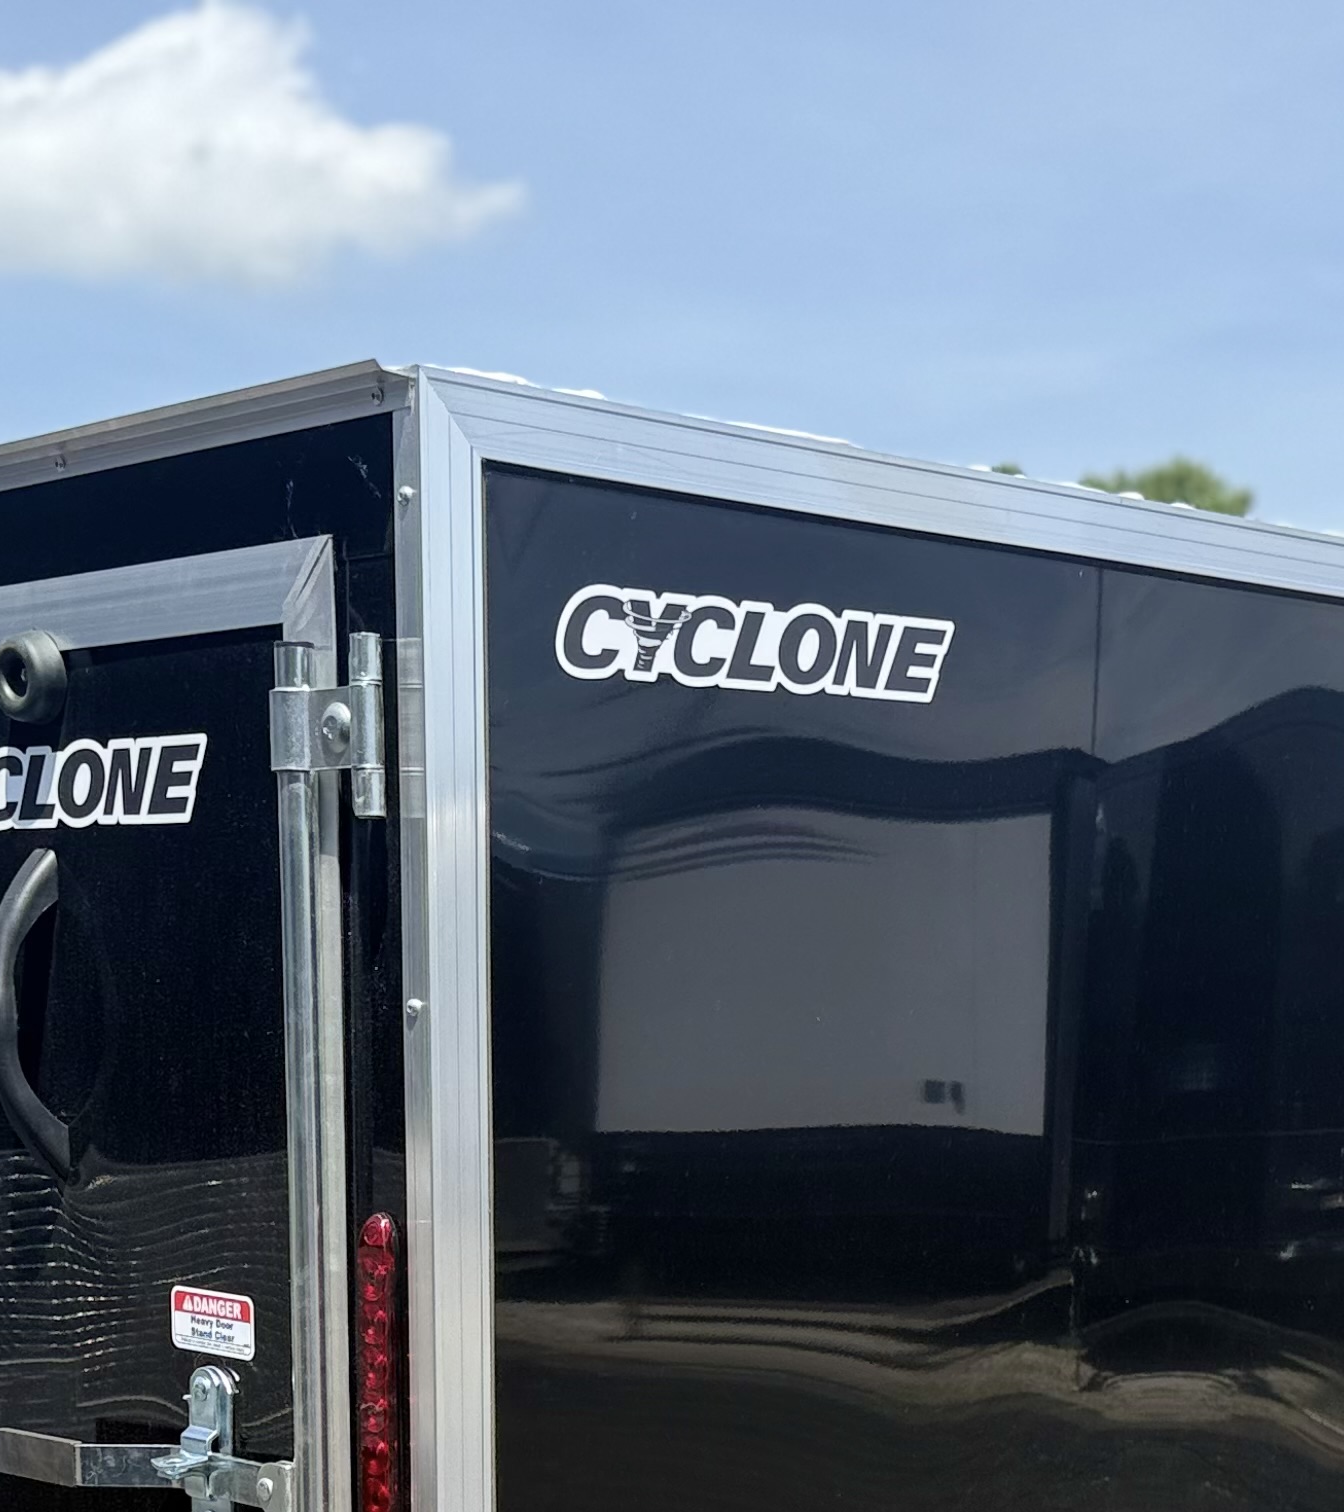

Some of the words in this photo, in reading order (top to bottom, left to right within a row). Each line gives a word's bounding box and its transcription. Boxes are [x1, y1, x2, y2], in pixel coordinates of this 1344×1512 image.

[558, 587, 953, 700] CYCLONE
[193, 1295, 242, 1320] DANGER
[190, 1315, 214, 1329] Heavy
[216, 1319, 233, 1330] Door
[191, 1327, 213, 1339] Stand
[214, 1330, 235, 1342] Clear
